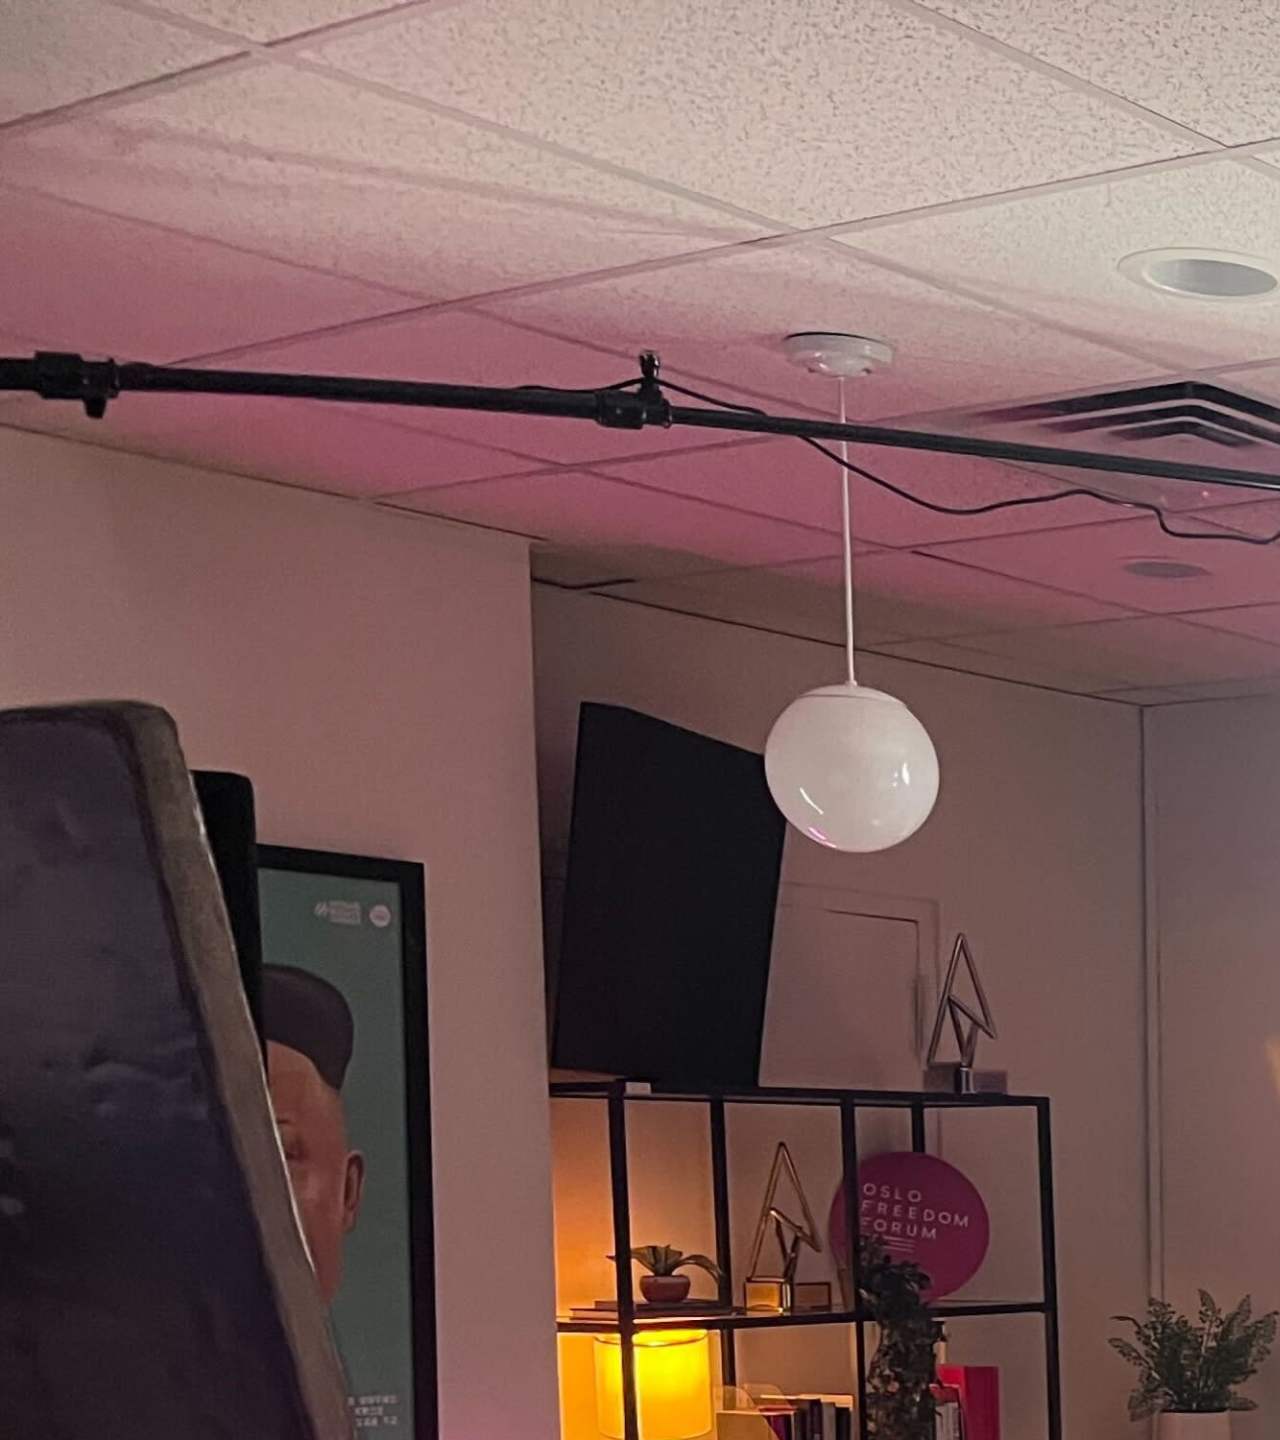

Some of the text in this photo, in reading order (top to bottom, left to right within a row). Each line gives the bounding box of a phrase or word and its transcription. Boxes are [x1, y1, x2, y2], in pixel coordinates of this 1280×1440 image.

[863, 1183, 922, 1203] OSLO
[861, 1200, 969, 1228] FREEDOM
[860, 1217, 937, 1239] FORUM
